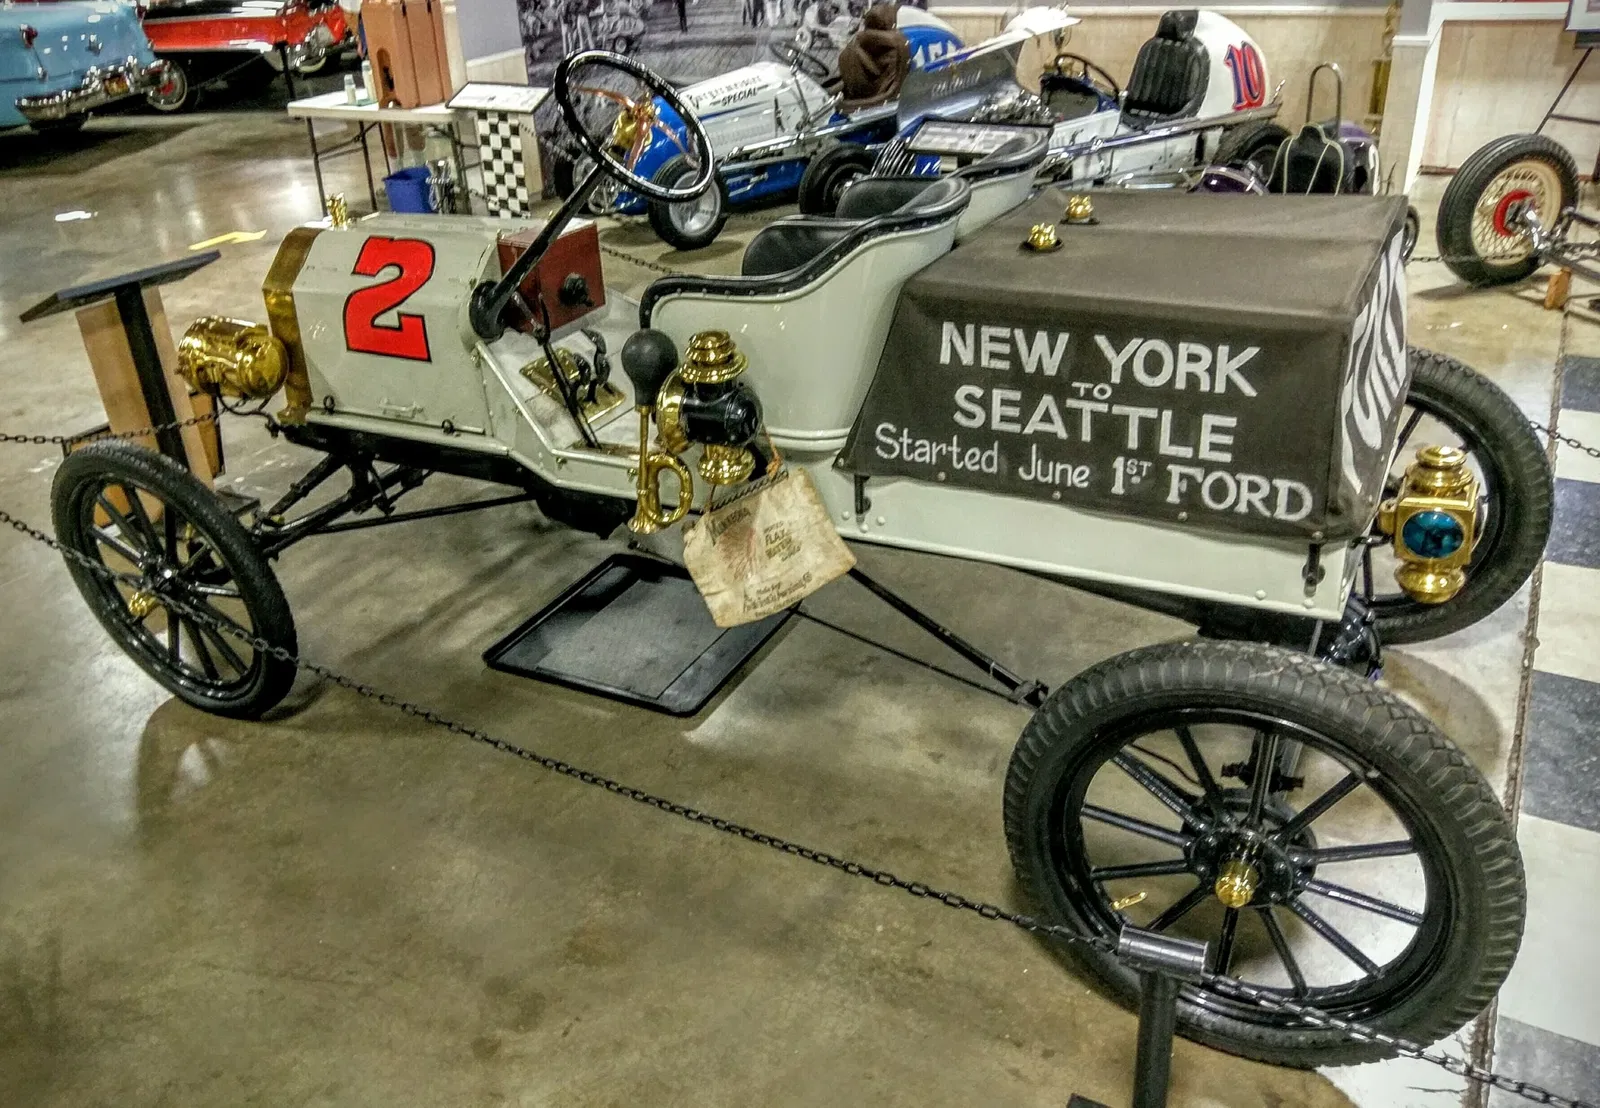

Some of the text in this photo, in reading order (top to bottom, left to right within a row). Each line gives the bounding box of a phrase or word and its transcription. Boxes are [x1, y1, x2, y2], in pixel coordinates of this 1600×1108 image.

[722, 86, 758, 106] SPECIAL
[1224, 40, 1266, 110] 10
[343, 236, 436, 362] 2
[939, 321, 1261, 397] NEW YORK
[1071, 381, 1113, 400] TO
[952, 384, 1238, 463] SEATTLE
[874, 422, 999, 474] Started
[1018, 443, 1090, 488] June
[1166, 464, 1313, 522] FORD
